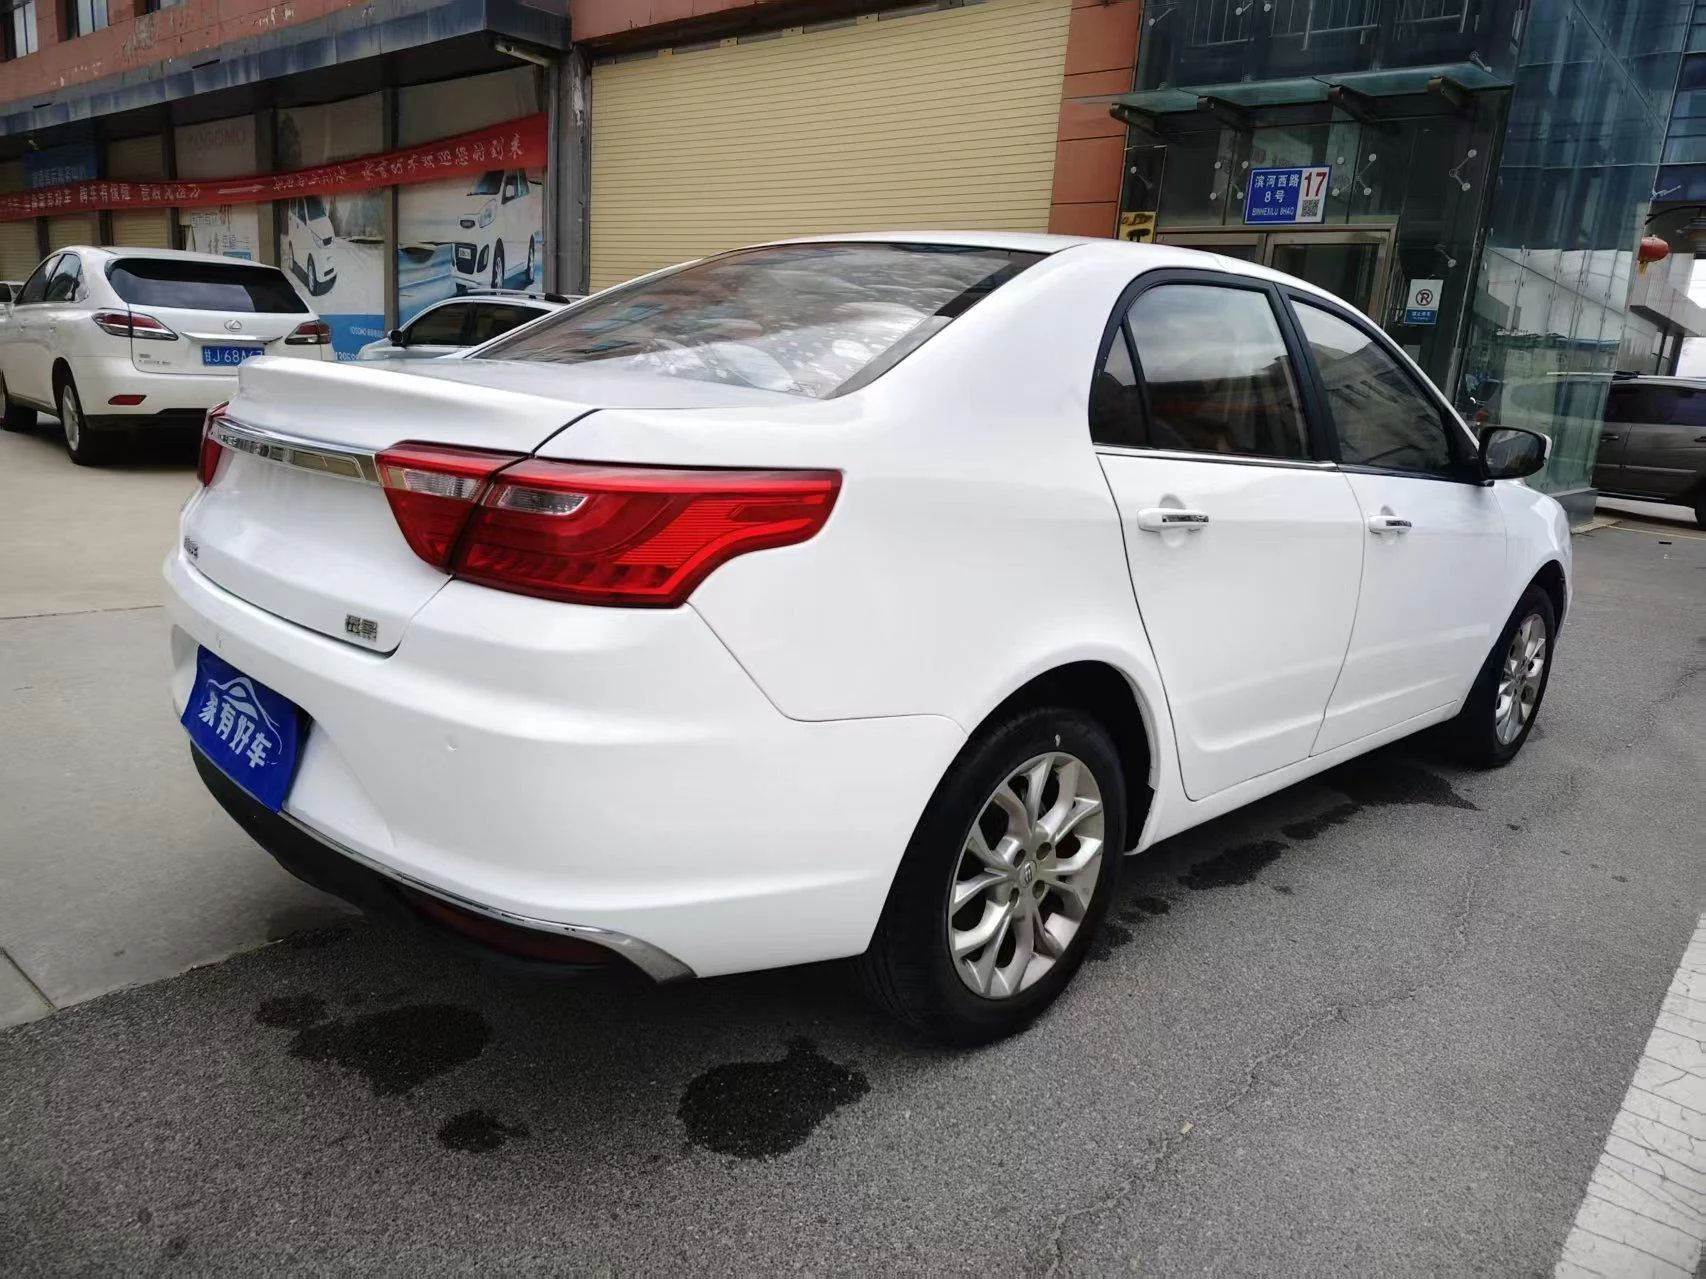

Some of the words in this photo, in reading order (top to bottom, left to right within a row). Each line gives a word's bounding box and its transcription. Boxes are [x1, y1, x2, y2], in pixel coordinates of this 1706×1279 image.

[1255, 174, 1300, 188] 滨河西路
[1304, 172, 1328, 197] 17
[198, 691, 272, 768] 家有好车
